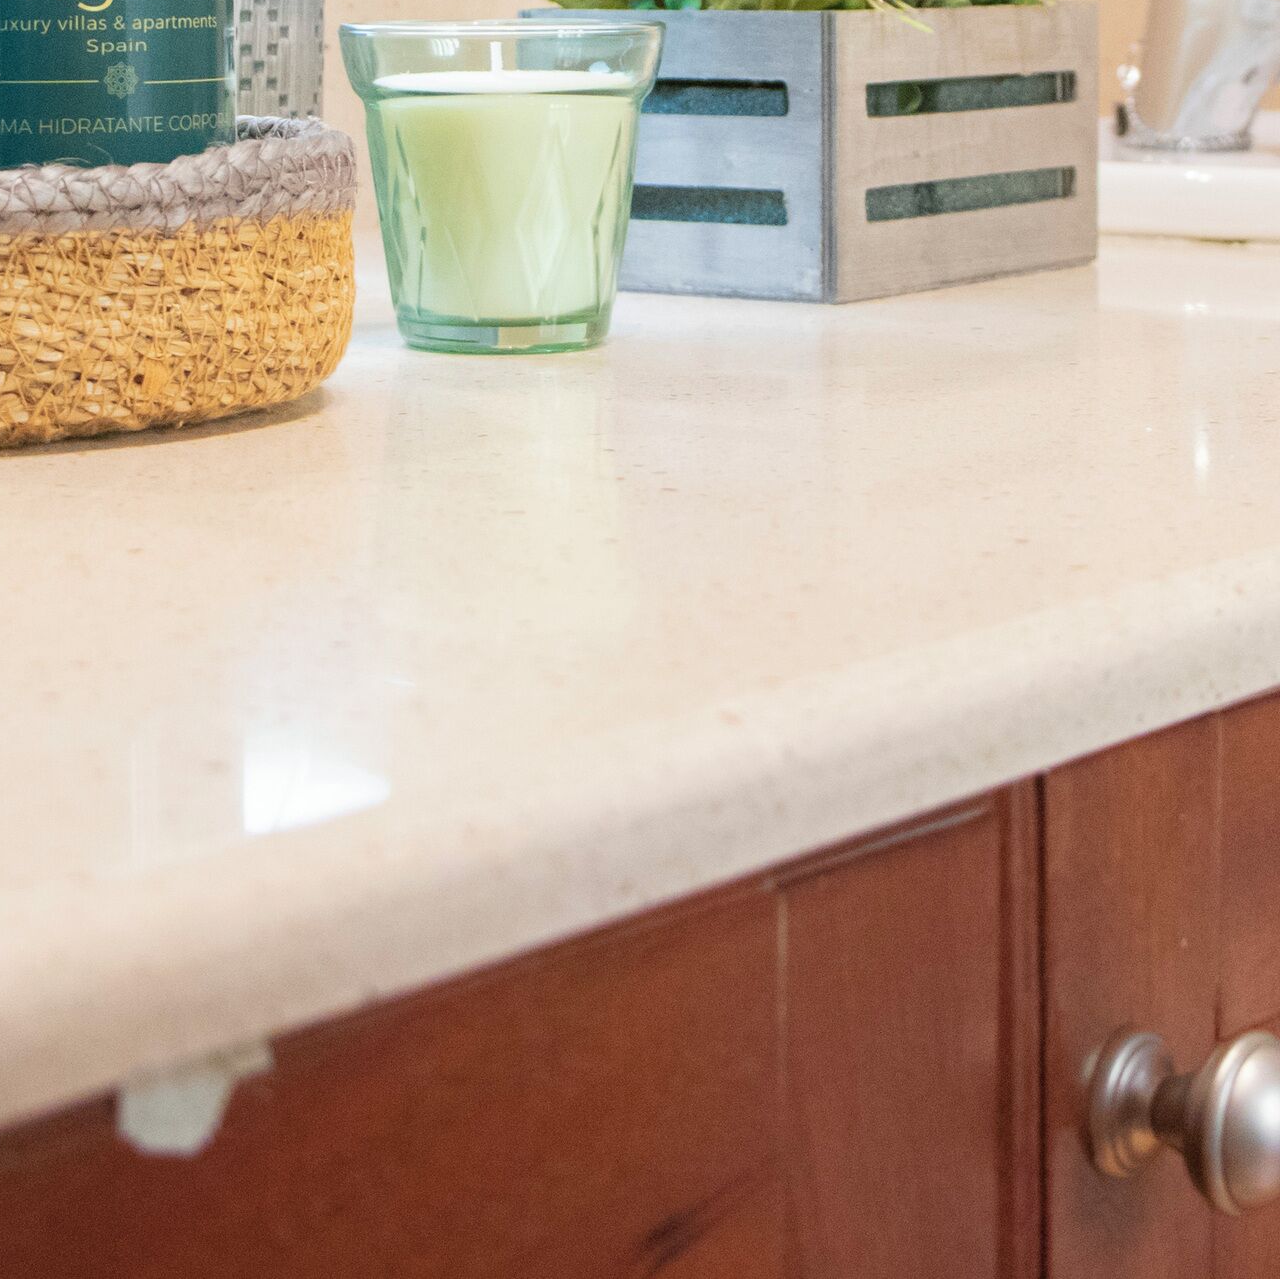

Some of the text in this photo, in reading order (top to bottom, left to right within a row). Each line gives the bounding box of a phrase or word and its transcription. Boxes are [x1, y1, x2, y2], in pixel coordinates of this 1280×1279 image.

[0, 14, 218, 35] uxury villas & apartments
[86, 38, 148, 56] Spain
[0, 118, 34, 134] MA
[38, 115, 164, 135] HIDRATANTE
